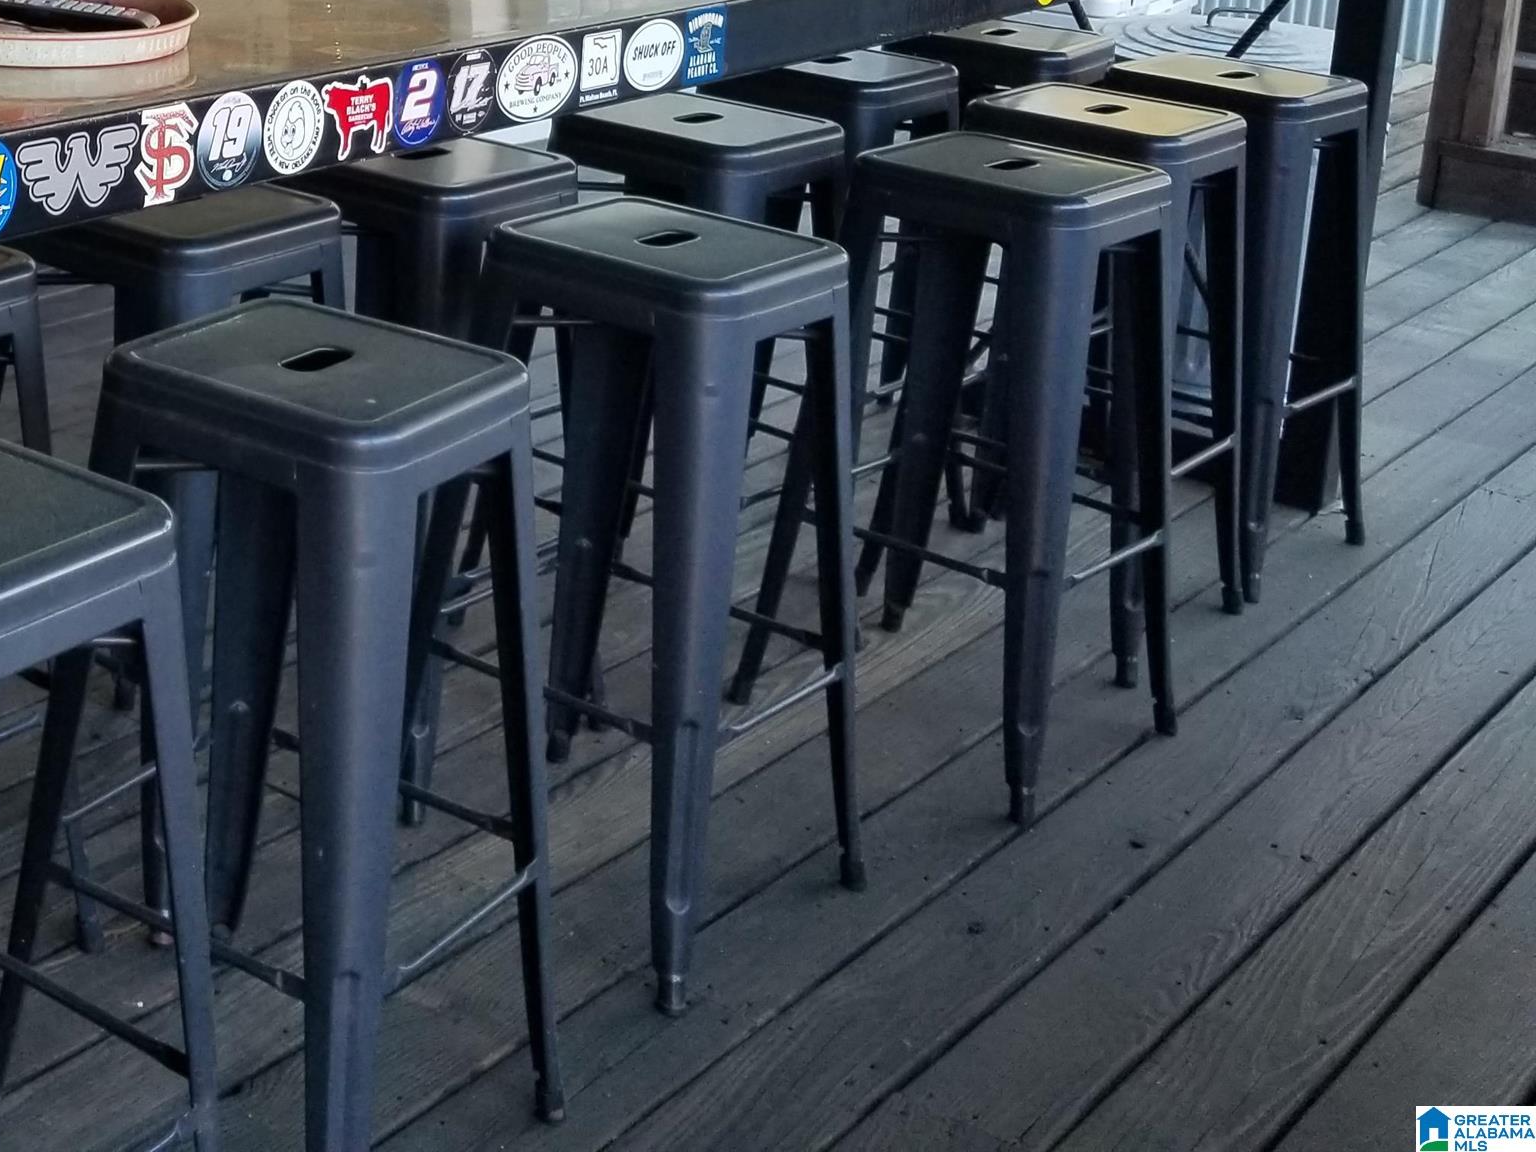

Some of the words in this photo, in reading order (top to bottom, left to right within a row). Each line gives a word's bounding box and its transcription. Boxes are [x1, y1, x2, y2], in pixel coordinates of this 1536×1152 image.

[508, 46, 533, 73] GOOD
[536, 42, 568, 64] PEOPLE
[632, 43, 660, 61] SHUCK
[661, 40, 677, 56] OFF
[689, 51, 716, 68] ALABAMA
[588, 55, 608, 77] 30A
[687, 64, 708, 79] PEANUT
[350, 94, 374, 106] TERRY
[400, 69, 438, 122] 2
[509, 98, 535, 109] BREWING
[536, 92, 562, 103] COMPANY
[346, 102, 376, 115] BLACK'S
[209, 103, 253, 162] 19
